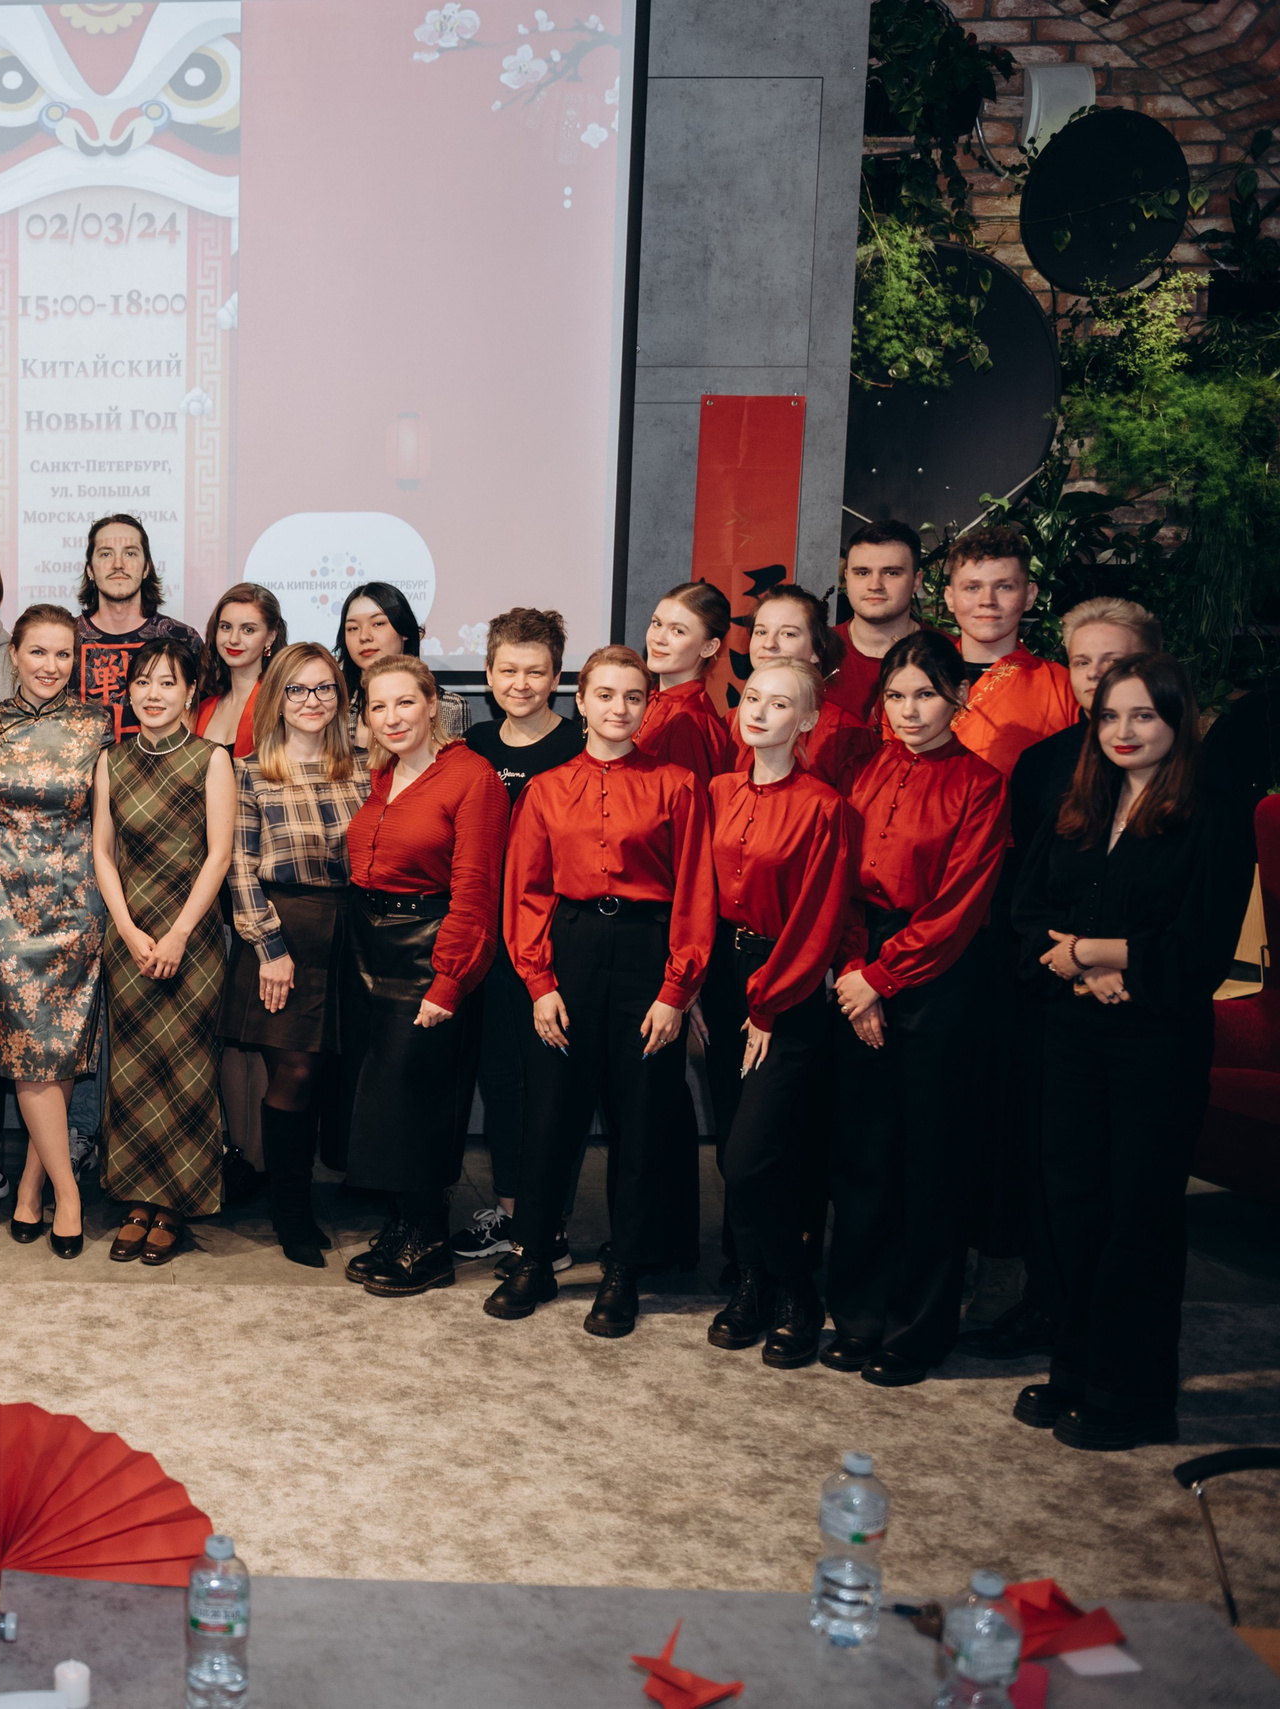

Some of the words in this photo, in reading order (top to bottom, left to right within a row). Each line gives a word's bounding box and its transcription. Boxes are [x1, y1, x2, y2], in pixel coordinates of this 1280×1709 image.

[26, 203, 182, 246] 02/03/24
[19, 289, 187, 321] 15:00-18:00
[287, 581, 337, 590] КИПЕНИЯ
